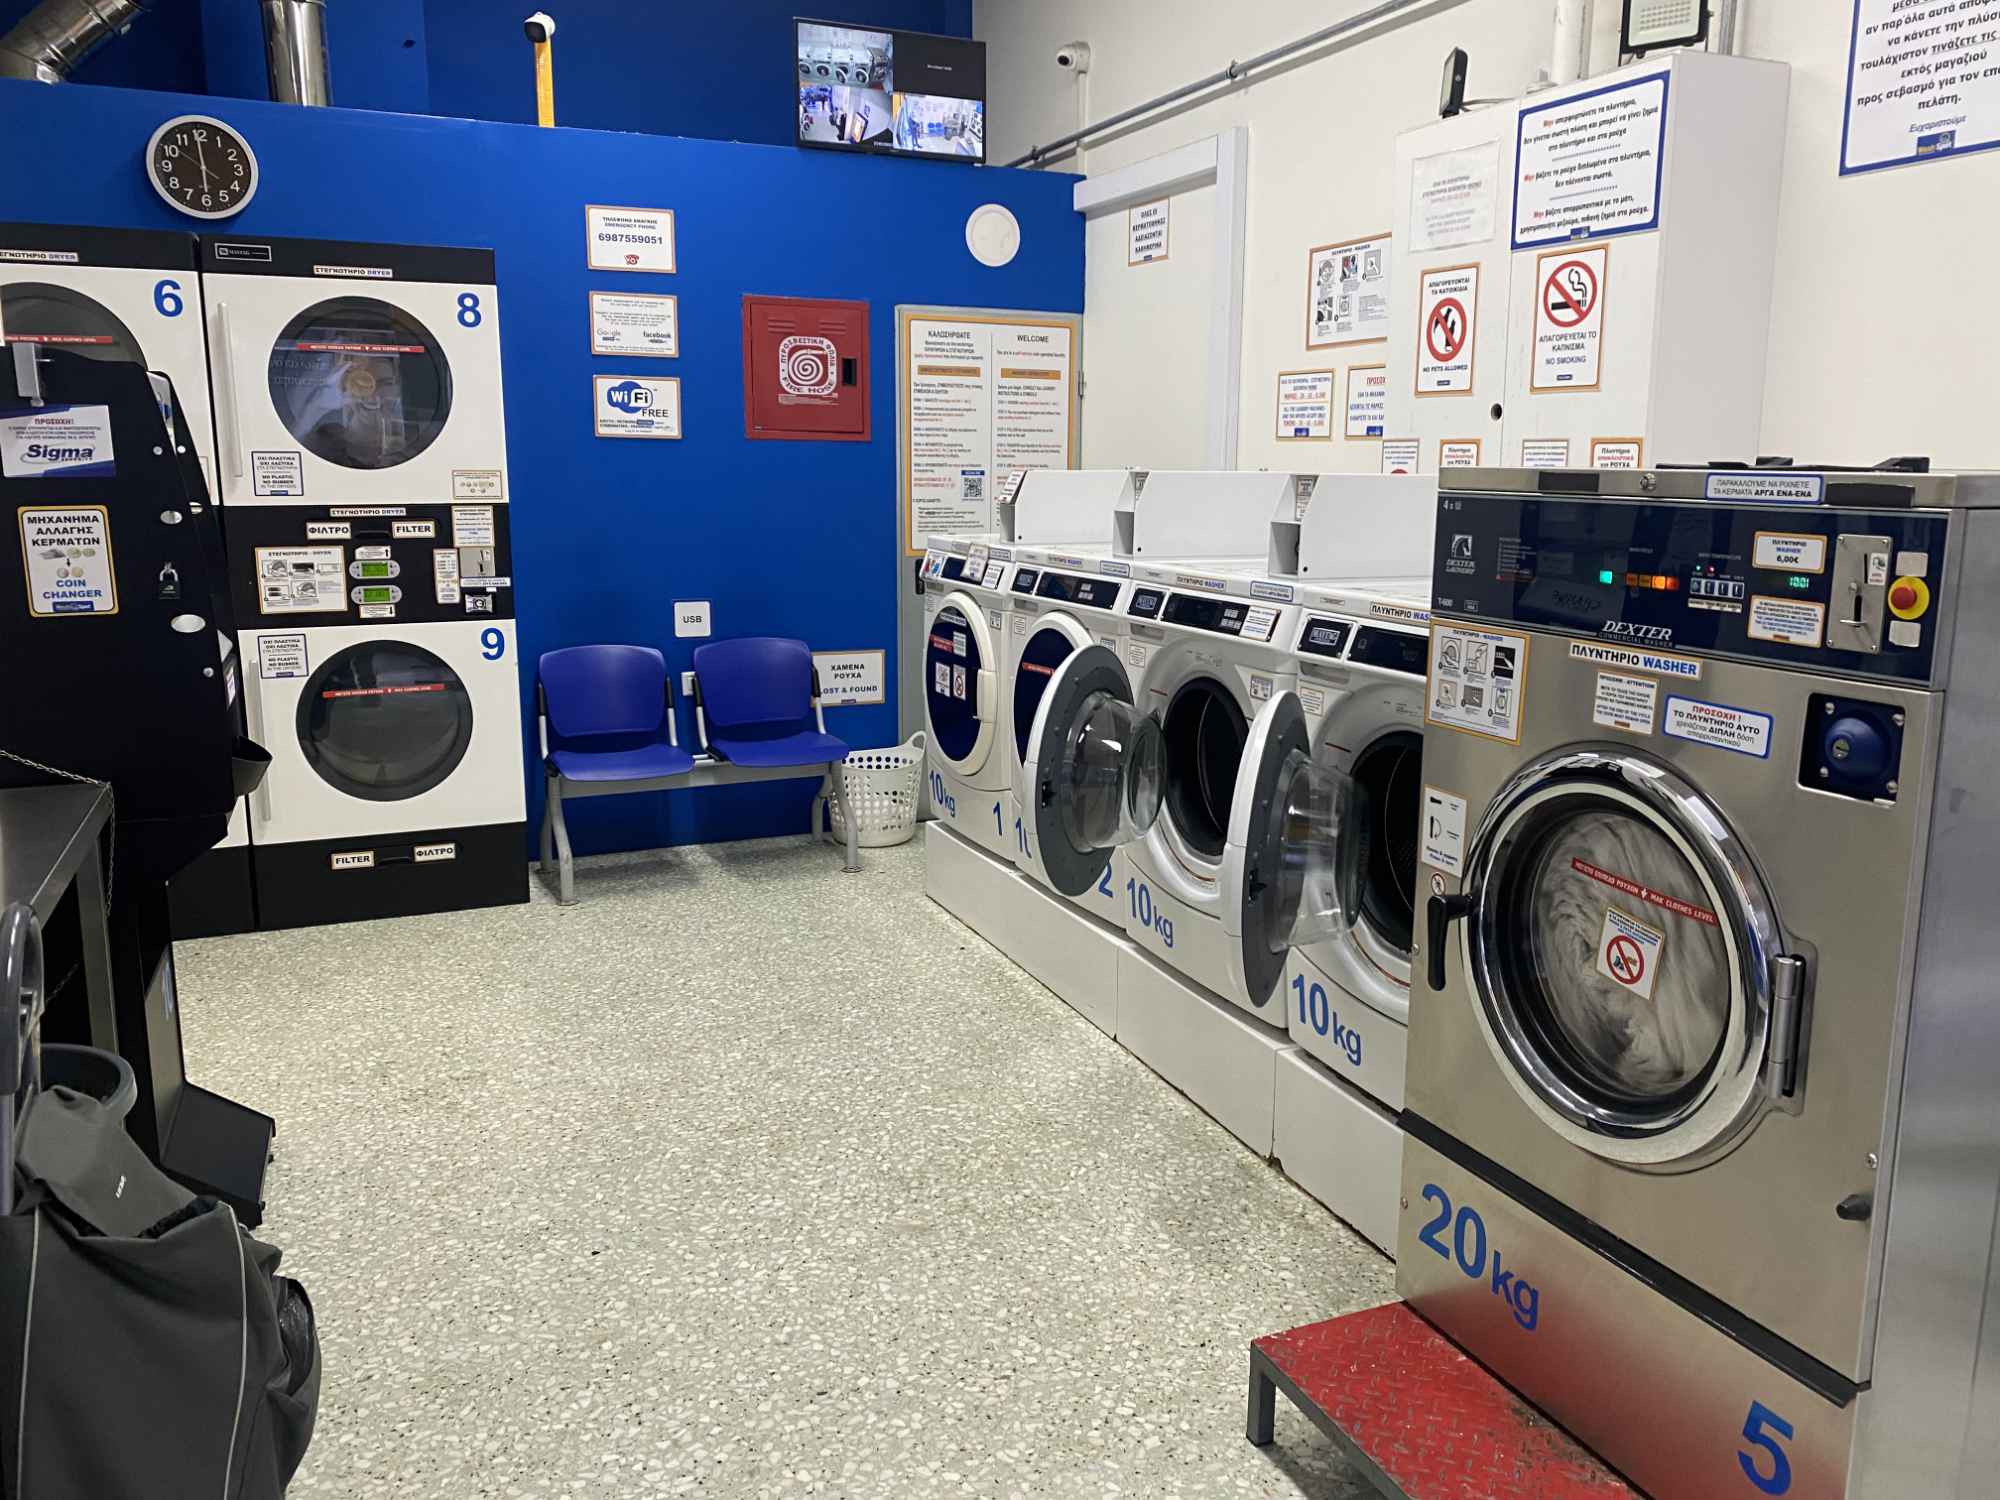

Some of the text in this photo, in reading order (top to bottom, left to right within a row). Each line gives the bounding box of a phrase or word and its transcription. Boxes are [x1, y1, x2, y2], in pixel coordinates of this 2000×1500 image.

[1866, 25, 1878, 35] αν
[1888, 37, 1901, 46] να
[1904, 26, 1941, 42] κάνετε
[1945, 20, 1965, 32] την
[1861, 30, 1997, 71] τουλάχιστον τινάζετε τις
[1901, 48, 1988, 78] εκτός μαγαζιού
[1857, 93, 1883, 106] προς
[1886, 80, 1935, 99] σεβασμό
[1939, 76, 1956, 89] για
[1960, 71, 1980, 83] τον
[1918, 93, 1962, 109] πελάτη.
[1909, 115, 1967, 132] Ευχαριστούμε
[176, 133, 188, 146] 11
[192, 128, 208, 142] 12
[216, 135, 221, 148] 1
[164, 145, 179, 157] 10
[227, 148, 237, 161] 2
[162, 160, 172, 172] 9
[234, 164, 243, 176] 3
[169, 177, 179, 189] 8
[230, 180, 240, 192] 4
[184, 188, 194, 200] 7
[201, 194, 212, 207] 6
[219, 190, 229, 202] 5
[598, 232, 662, 245] 6987559051
[153, 279, 183, 318] 6
[457, 292, 482, 328] 8
[1539, 331, 1597, 343] ΑΠΑΓΟΡΕΥΕΤΑΙ ΤΟ
[1551, 342, 1585, 352] ΚΑΠΝΙΣΜΑ
[1545, 355, 1587, 365] NO SMOKING
[782, 376, 834, 394] FIRE HOSE
[642, 409, 669, 418] FREE
[26, 444, 94, 462] Sigma
[27, 515, 99, 525] ΜΗΧΑΝΗΜΑ
[36, 526, 94, 536] ΑΛΛΑΓΗΣ
[308, 526, 349, 534] ΦΙΛΤΡΟ
[396, 525, 432, 534] FILTER
[31, 537, 100, 547] ΚΕΡΜΑΤΩΝ
[1776, 555, 1799, 564] 6,00€
[56, 579, 87, 588] COIN
[42, 589, 103, 600] CHANGER
[1371, 605, 1412, 619] ΠΛΥΝΤΗΡΙΟ
[683, 615, 702, 623] USB
[1602, 620, 1673, 641] DEXTER
[480, 628, 505, 661] 9
[1645, 638, 1673, 648] WASHER
[1572, 645, 1697, 675] ΠΛΥΝΤΗΡΙΟ WASHER
[1693, 705, 1736, 721] ΠΡΟΣΟΧΗ
[1673, 710, 1760, 735] ΤΟ ΠΛΥΝΤΗΡΙΟ ΑΥΤΟ
[1709, 727, 1735, 738] ΔΙΠΛΗ
[930, 770, 956, 818] 10 kg
[993, 802, 1002, 836] 1
[416, 847, 454, 858] ΦΙΛΤΡΟ
[335, 854, 371, 865] FILTER
[1099, 862, 1114, 898] 2
[1127, 878, 1173, 948] 10 kg
[1650, 893, 1715, 922] MAX CLOTHES LEVEL
[1292, 974, 1361, 1066] 10 kg
[1418, 1183, 1539, 1332] 20 kg
[1738, 1400, 1794, 1496] 5
